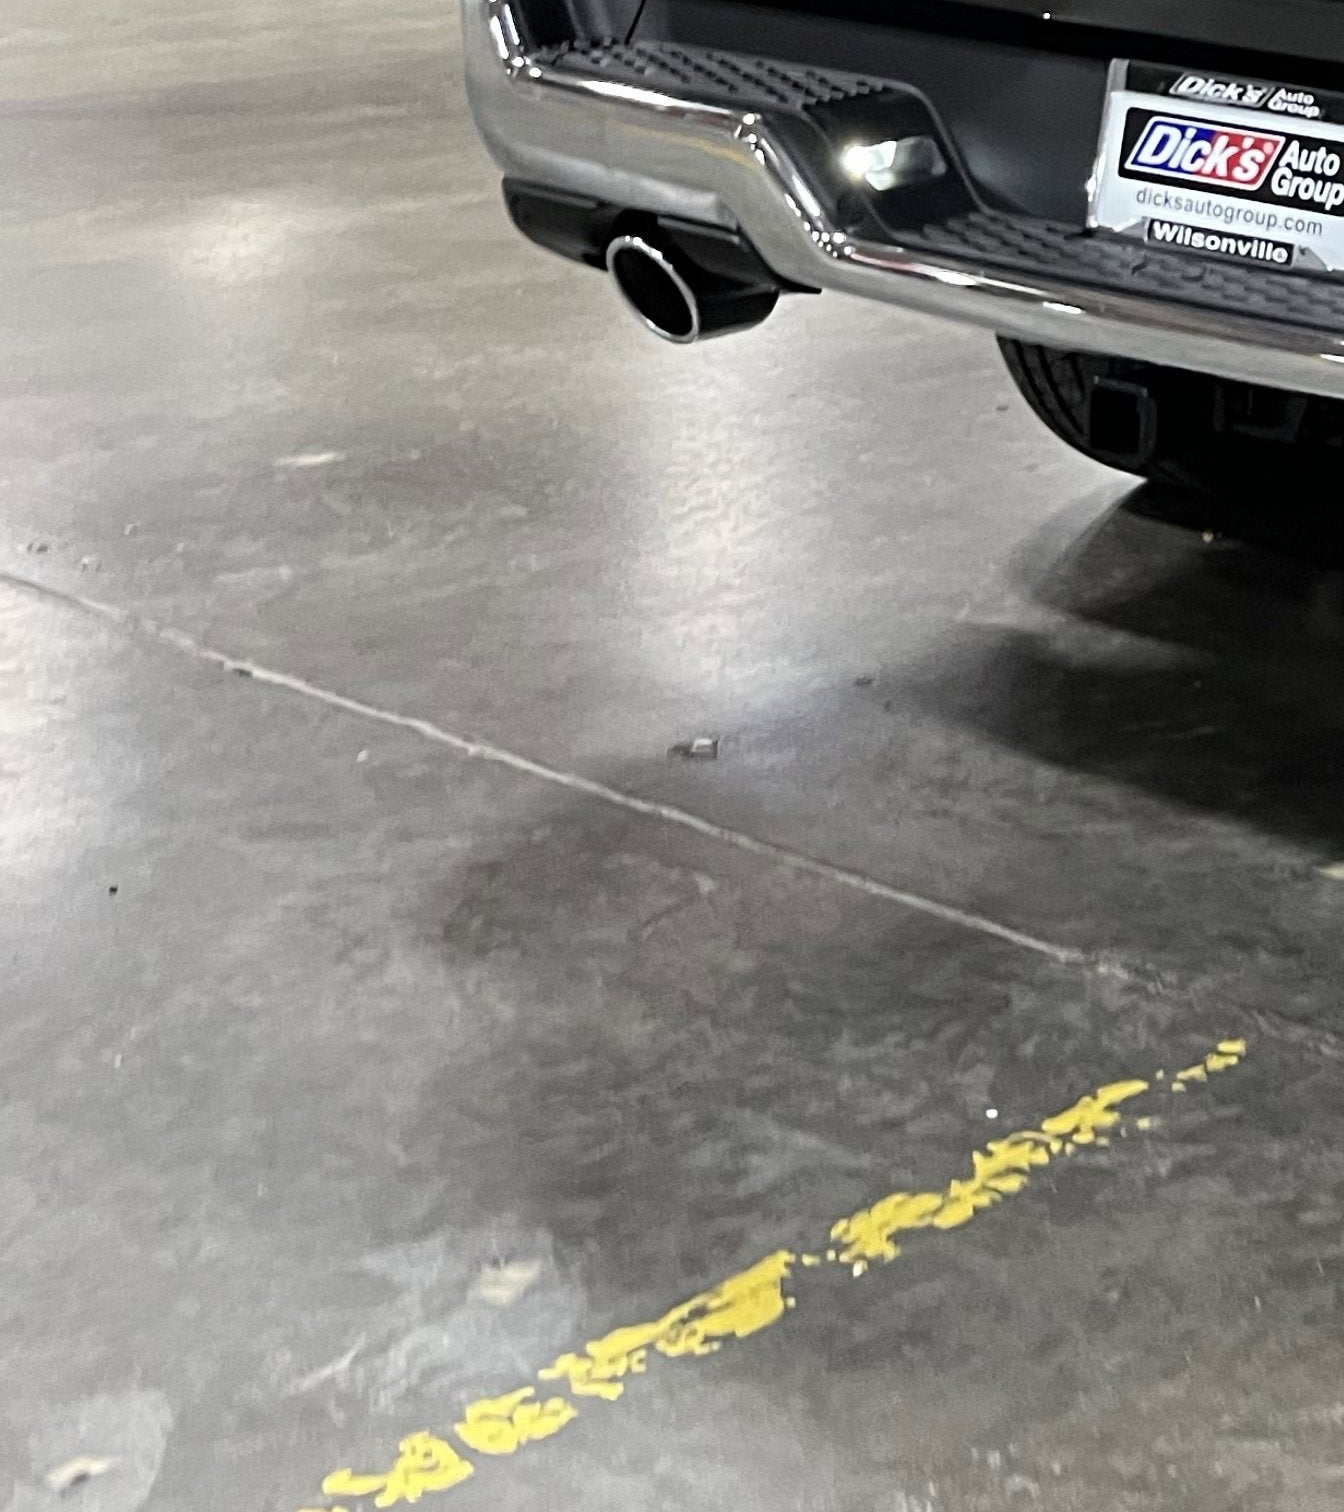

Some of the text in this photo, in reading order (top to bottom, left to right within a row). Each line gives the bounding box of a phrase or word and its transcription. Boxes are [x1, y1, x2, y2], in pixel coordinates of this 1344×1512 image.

[1267, 98, 1321, 119] Group
[1271, 87, 1315, 106] Auto
[1135, 123, 1340, 182] Dick's Auto
[1135, 186, 1323, 236] dicksautogroup.com
[1153, 220, 1289, 264] Wilsonville
